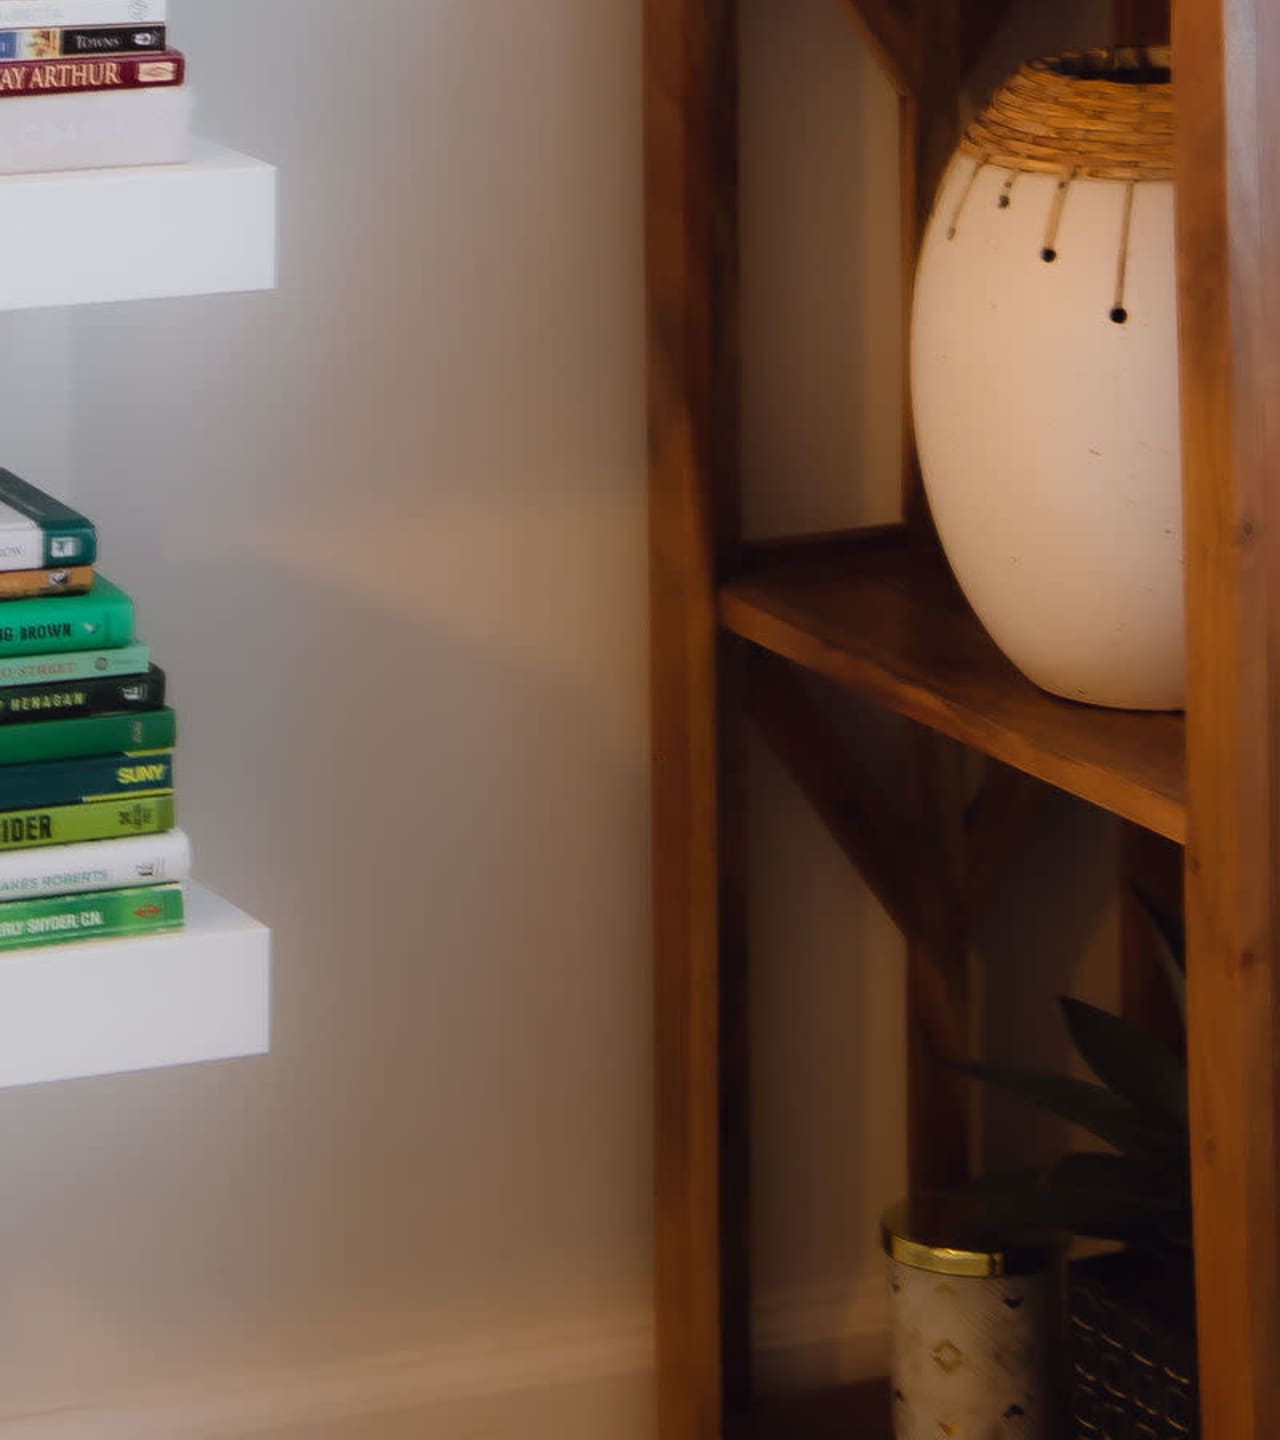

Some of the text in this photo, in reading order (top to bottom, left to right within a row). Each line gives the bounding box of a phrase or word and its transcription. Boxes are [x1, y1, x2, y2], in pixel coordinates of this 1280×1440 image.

[29, 63, 122, 88] ARTHUR
[19, 623, 72, 639] BROWN
[11, 692, 85, 711] HENAGAN
[118, 764, 166, 784] SUNY
[42, 869, 108, 887] ROBERTS
